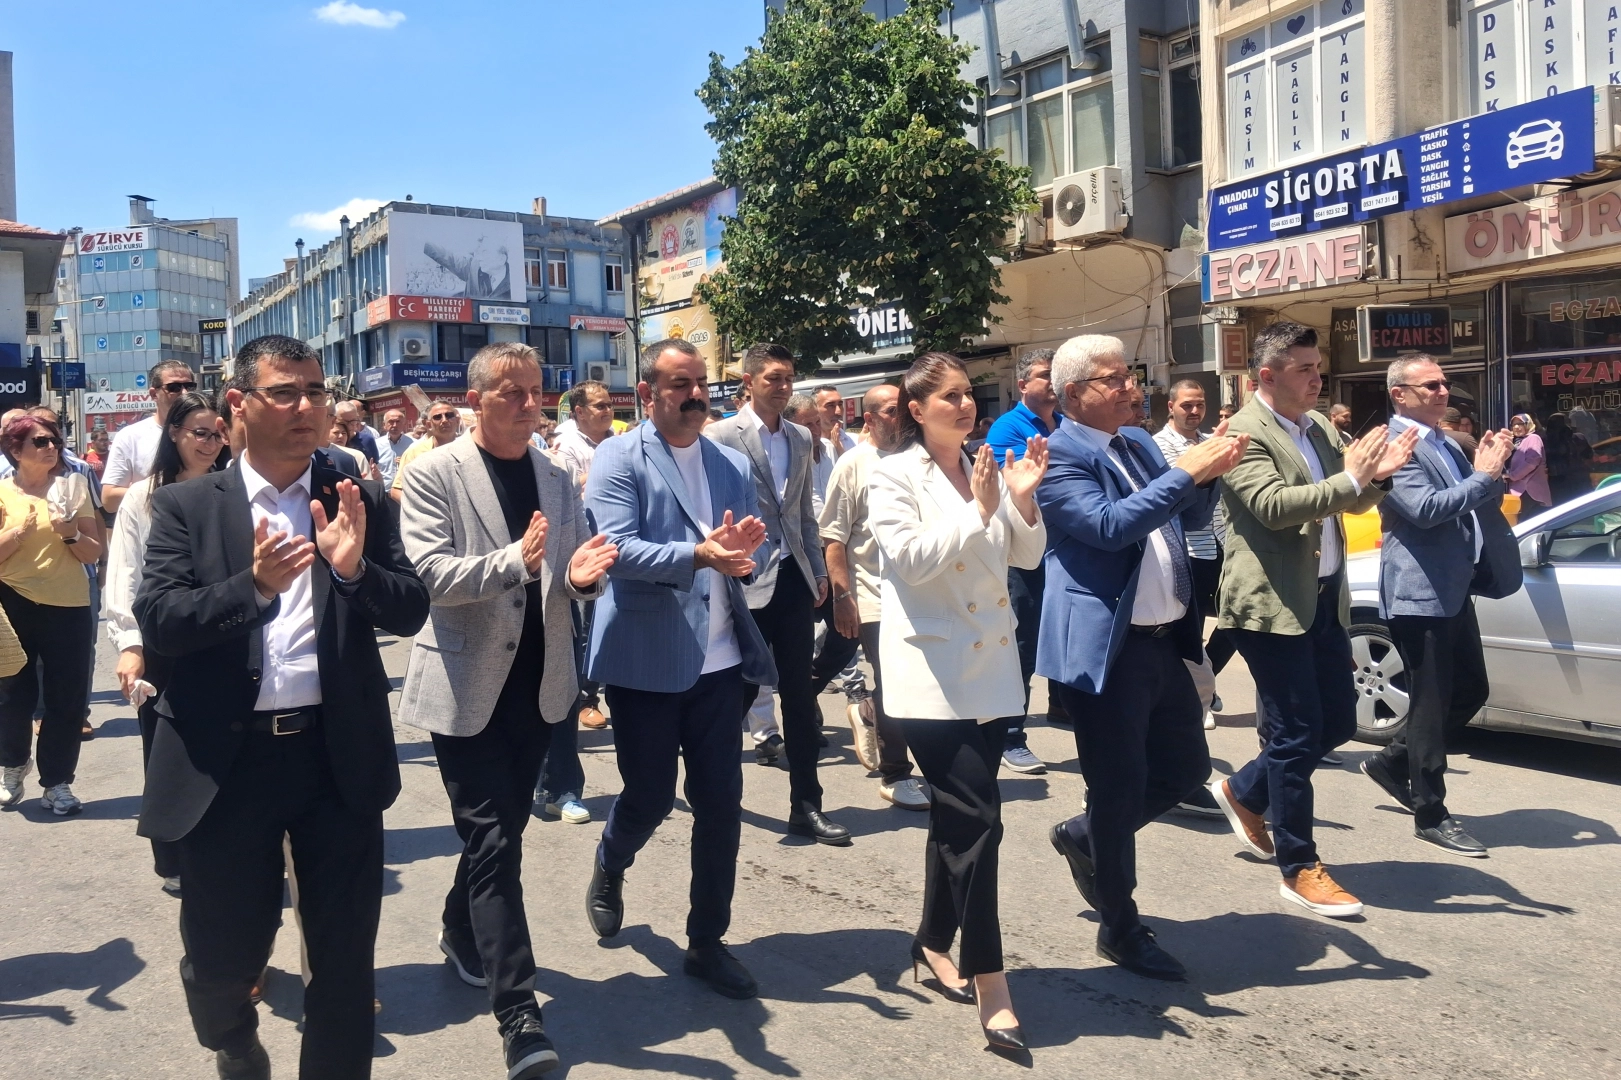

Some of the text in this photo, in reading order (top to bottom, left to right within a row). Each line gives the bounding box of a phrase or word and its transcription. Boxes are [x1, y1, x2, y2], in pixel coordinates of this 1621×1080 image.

[1483, 13, 1499, 112] DASK
[1340, 33, 1350, 141] YANGIN
[1291, 62, 1301, 151] SAĞLIK
[1244, 72, 1254, 169] TARSİM
[1420, 128, 1449, 142] TRAFİK
[1421, 139, 1447, 153] KASKO
[1421, 151, 1442, 163] DASK
[1421, 159, 1449, 173] YANGIN
[1265, 149, 1402, 209] SİGORTA
[1421, 170, 1449, 184] SAĞLIK
[1090, 172, 1098, 204] arçelik
[1421, 179, 1451, 193] TARSİM
[1219, 186, 1259, 206] ANADOLU
[1422, 191, 1444, 203] YEŞİL
[1227, 202, 1248, 216] ÇINAR
[1465, 190, 1621, 258] ÖMÜR
[96, 232, 143, 245] ZİRVE
[98, 243, 122, 252] SÜRÜCÜ
[1211, 234, 1360, 296] ECZANE
[423, 297, 465, 306] MİLLİYETÇİ
[428, 305, 461, 313] HAREKET
[1386, 311, 1433, 328] ÖMÜR
[690, 332, 708, 344] ARAS
[1371, 323, 1449, 347] ECZANESİ
[1227, 335, 1241, 363] E
[404, 369, 462, 379] BEŞİKTAŞ ÇARŞI
[115, 402, 139, 410] SÜRÜCÜ
